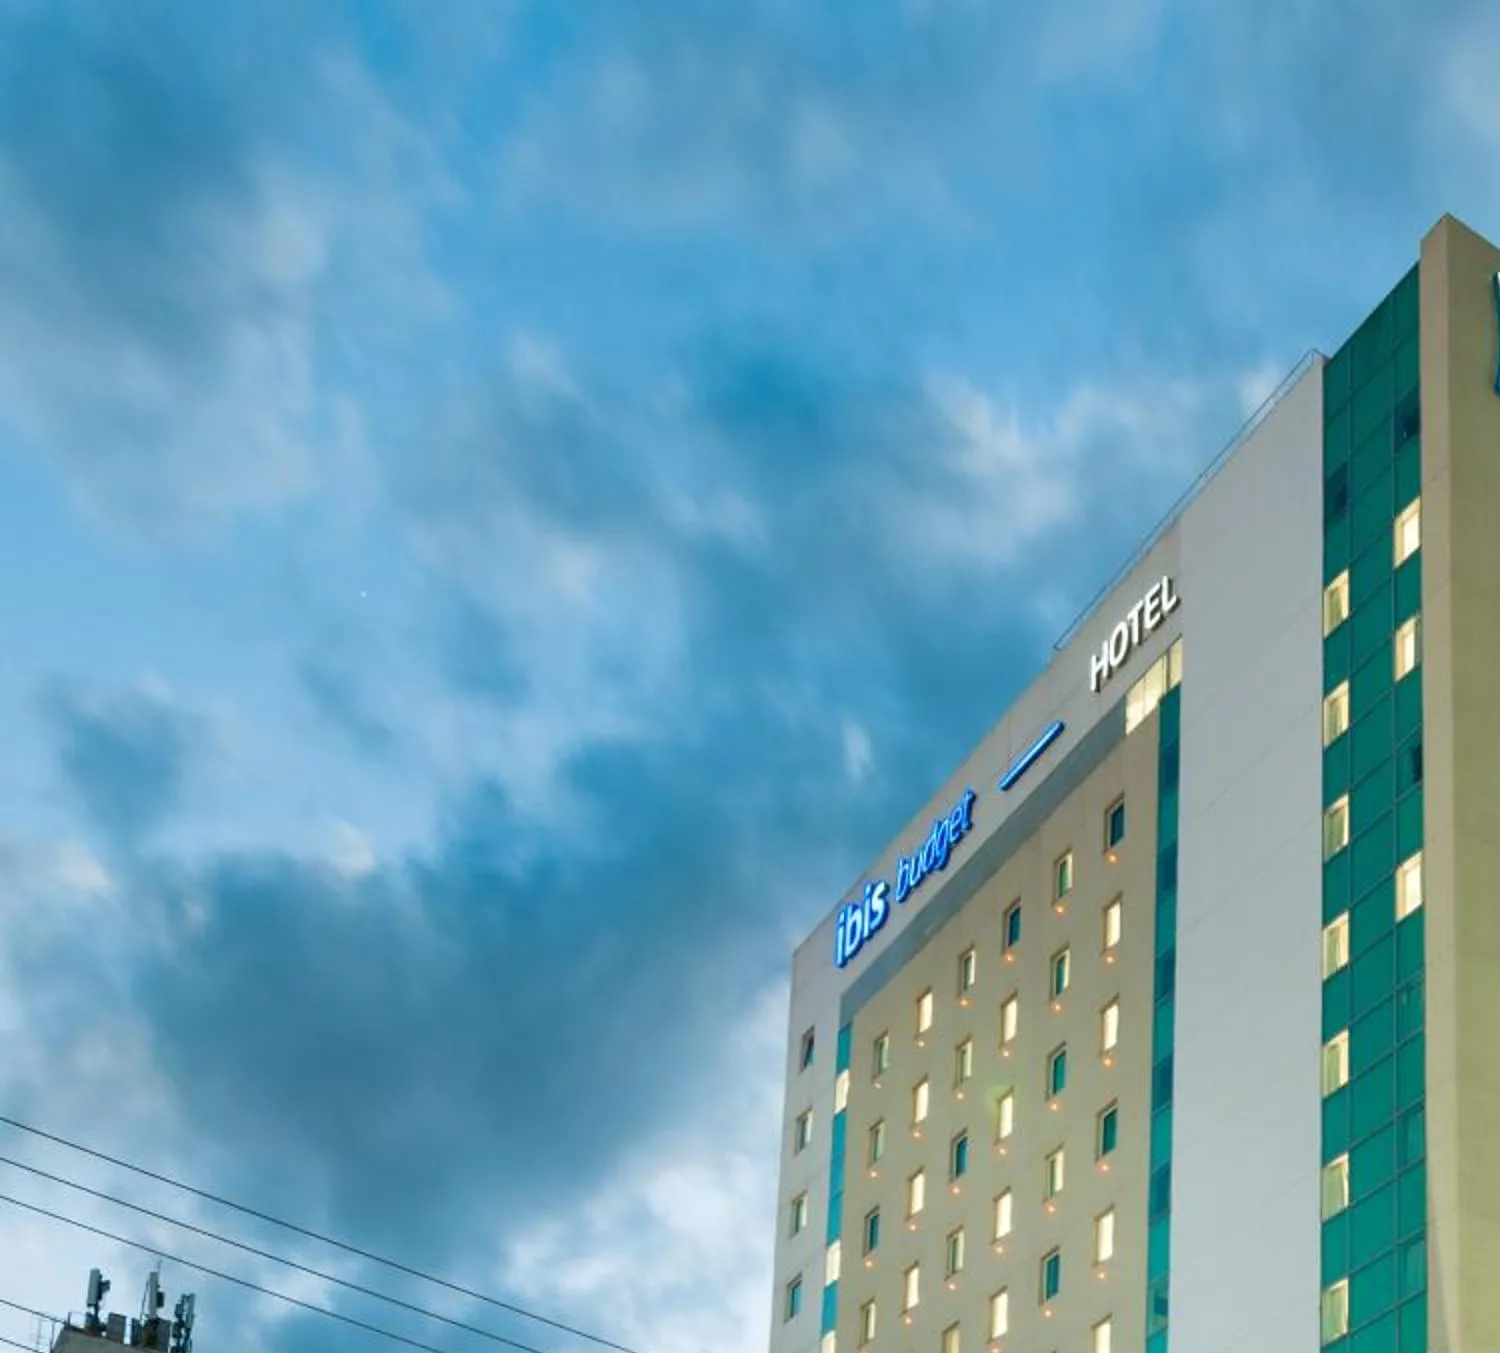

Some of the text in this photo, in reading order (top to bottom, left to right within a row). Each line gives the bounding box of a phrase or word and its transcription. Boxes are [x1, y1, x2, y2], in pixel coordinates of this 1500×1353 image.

[1090, 575, 1181, 692] HOTEL
[835, 788, 977, 968] ibis budget
